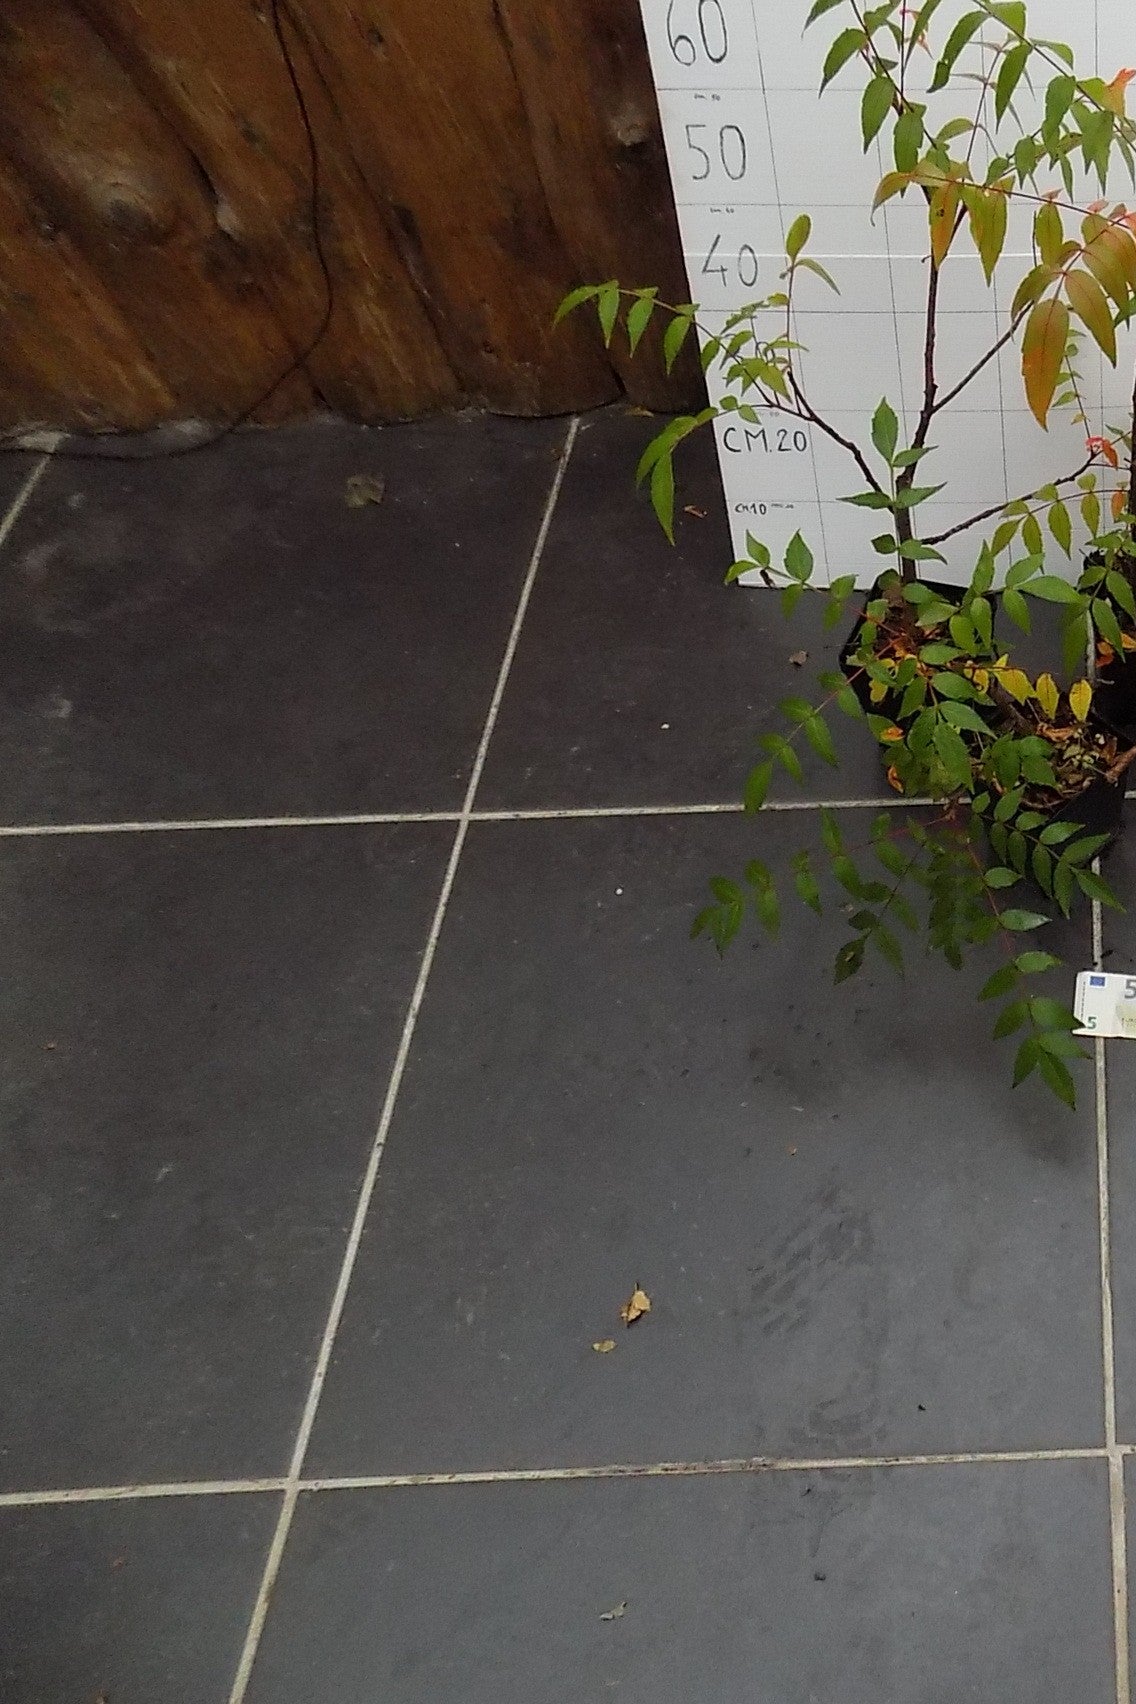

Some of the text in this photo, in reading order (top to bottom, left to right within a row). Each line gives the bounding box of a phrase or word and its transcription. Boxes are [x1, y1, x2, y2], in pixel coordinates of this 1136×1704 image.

[667, 0, 727, 66] 60
[685, 124, 746, 180] 50
[702, 234, 757, 286] 40
[1087, 1016, 1097, 1029] 5
